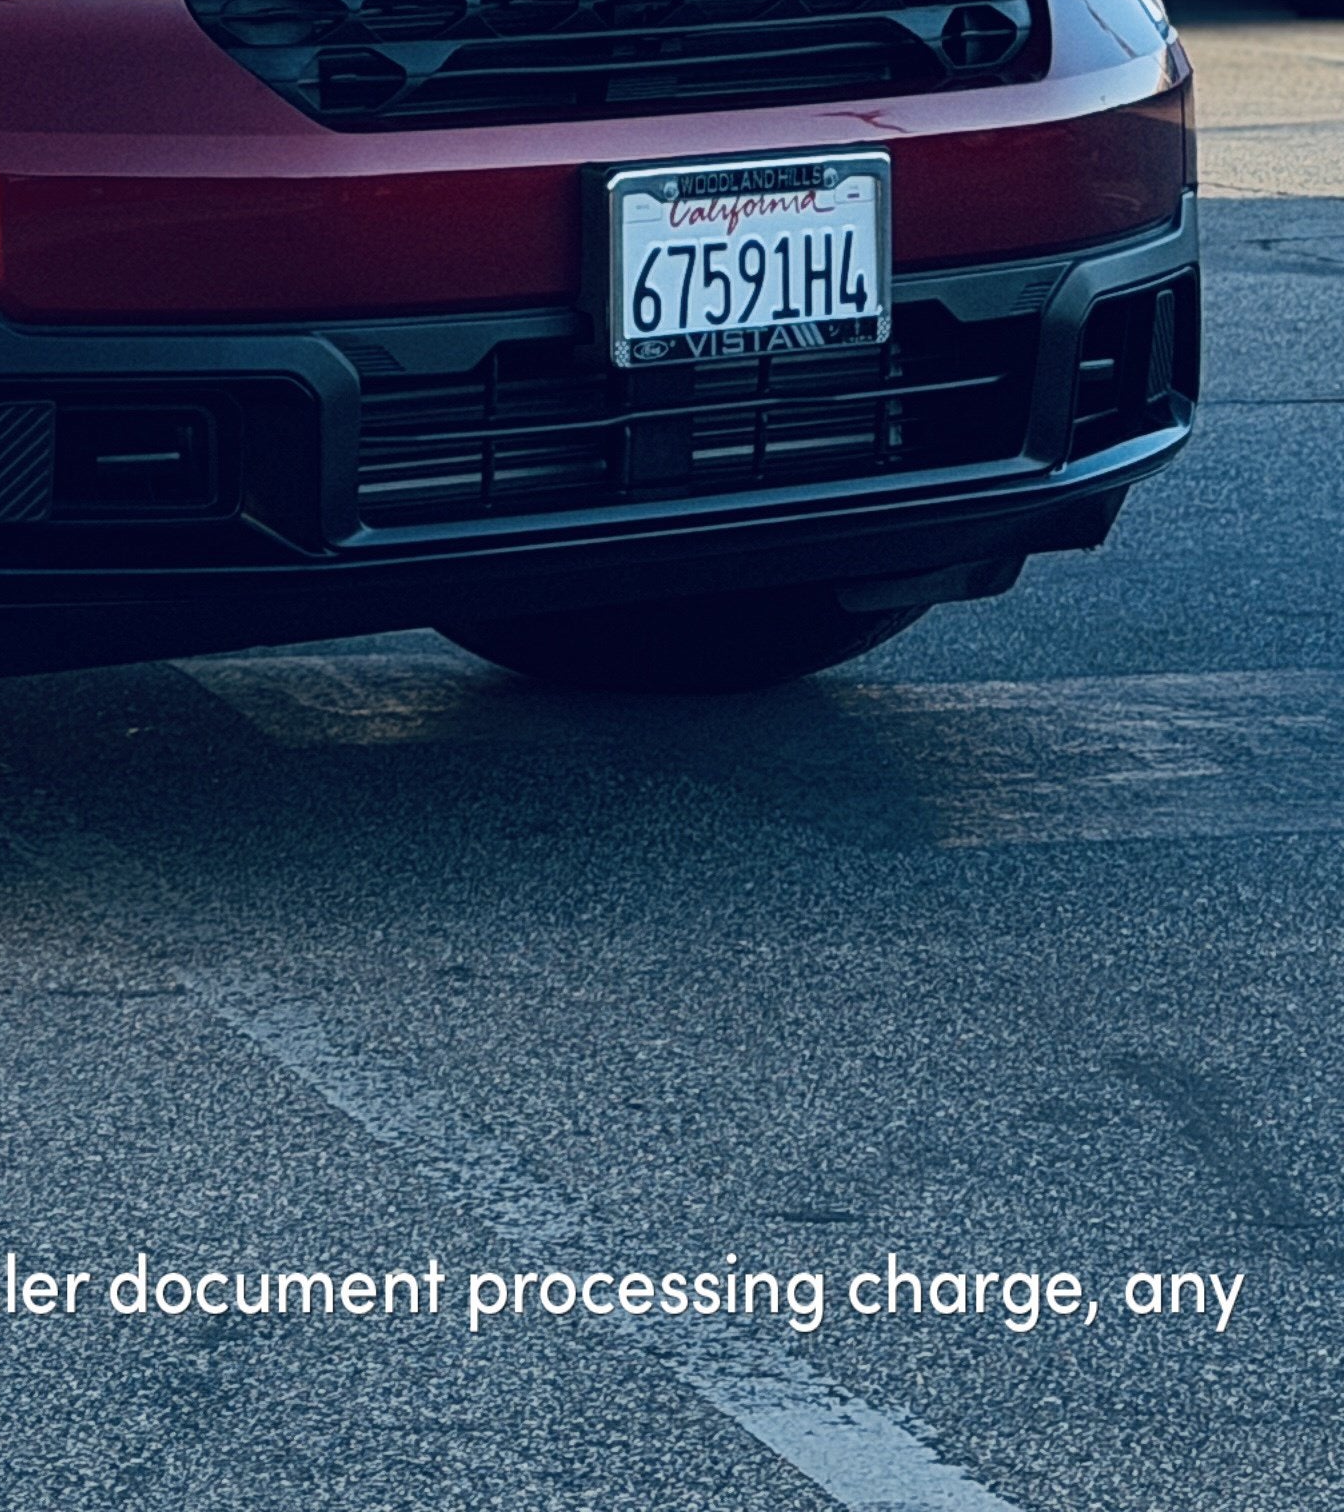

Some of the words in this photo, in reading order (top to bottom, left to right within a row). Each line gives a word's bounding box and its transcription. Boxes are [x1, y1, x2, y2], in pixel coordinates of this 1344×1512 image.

[680, 169, 775, 195] WOODLAND
[776, 165, 824, 189] HILLS
[669, 190, 834, 235] California
[632, 230, 868, 333] 67591H4
[683, 326, 796, 358] VISTA
